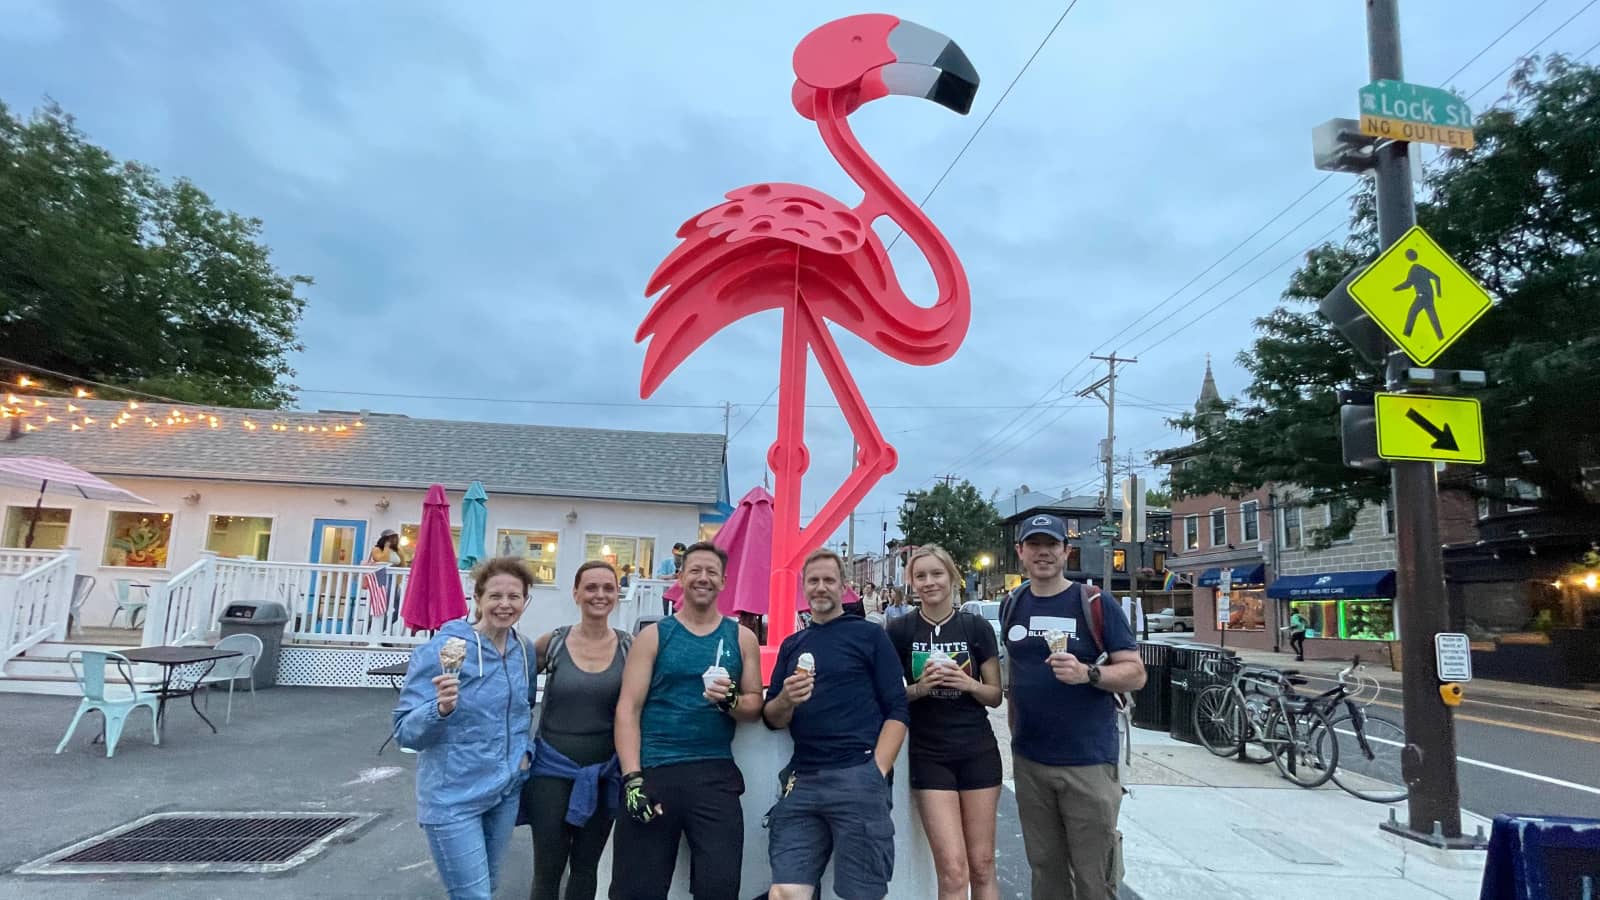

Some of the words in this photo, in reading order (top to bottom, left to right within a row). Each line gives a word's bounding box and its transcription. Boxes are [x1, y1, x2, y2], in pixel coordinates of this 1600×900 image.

[1381, 94, 1436, 122] Lock
[1446, 104, 1470, 127] St
[1367, 118, 1391, 135] NO
[1403, 123, 1466, 145] OUTLET
